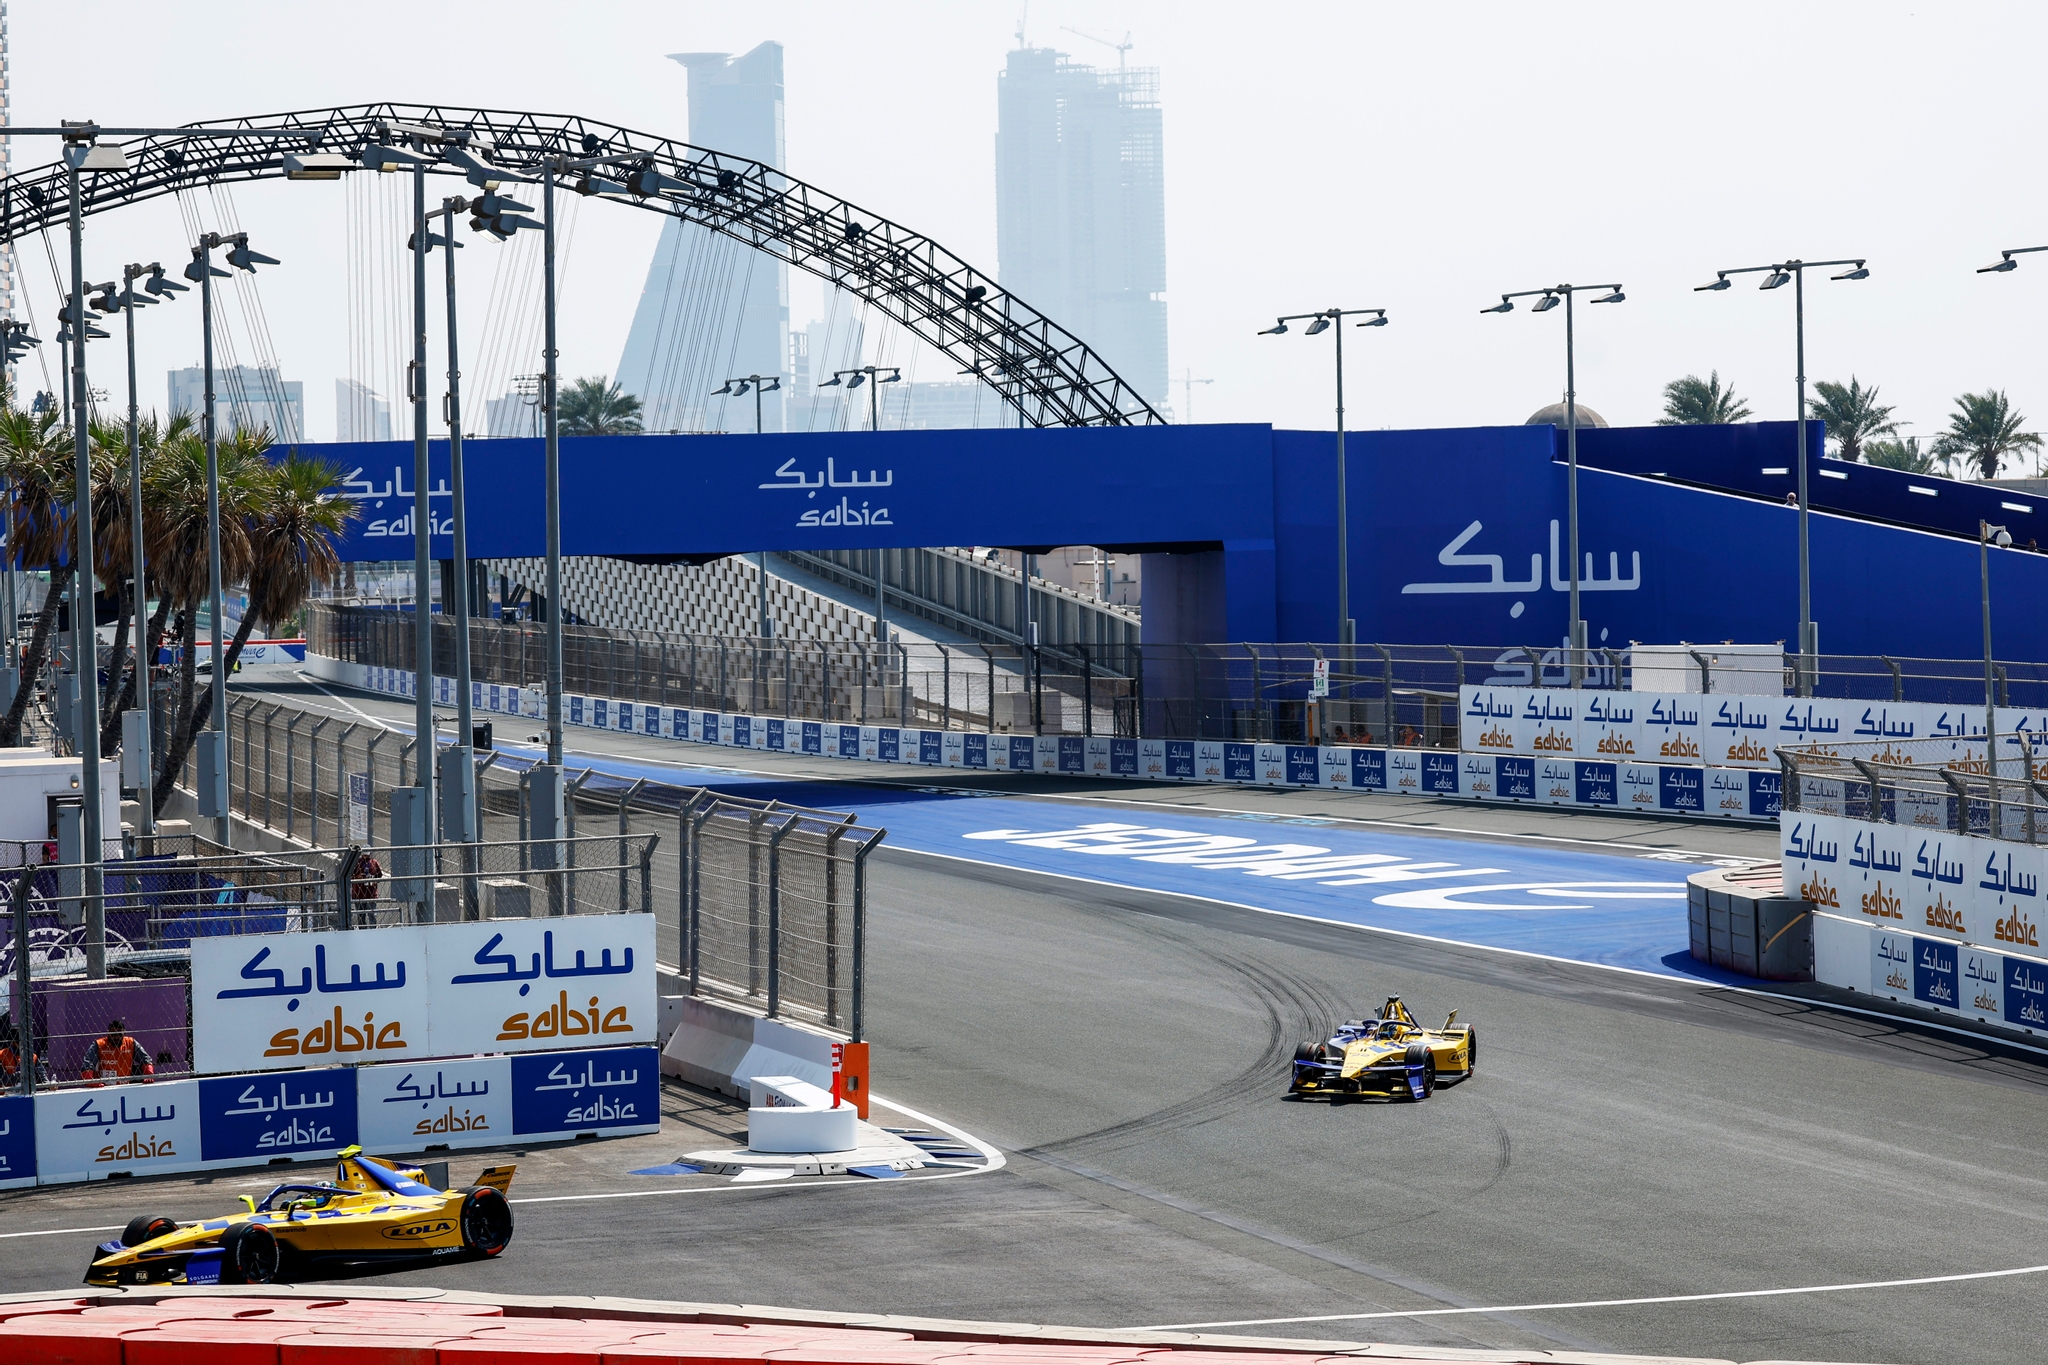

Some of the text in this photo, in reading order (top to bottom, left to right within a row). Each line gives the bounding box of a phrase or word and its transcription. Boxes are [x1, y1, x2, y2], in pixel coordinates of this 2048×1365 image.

[796, 497, 893, 526] sabic
[1479, 724, 1513, 748] sabic
[1534, 727, 1573, 751] sabic
[1597, 730, 1635, 754] sabic
[1660, 732, 1700, 757] sabic
[1727, 736, 1769, 761] sabic
[1509, 780, 1529, 795] sabic
[1549, 783, 1570, 798] sabic
[1590, 786, 1611, 801] sabic
[1632, 789, 1653, 804] sabic
[1675, 792, 1697, 807] sabic
[1719, 795, 1742, 810] sabic
[1765, 798, 1783, 813] sab
[962, 822, 1511, 886] JEDDAH
[1801, 870, 1840, 908] sabic
[1862, 881, 1903, 919] sabic
[1926, 893, 1966, 933] sabic
[1995, 905, 2038, 947] sabic
[1886, 968, 1908, 990] sabic
[1929, 978, 1951, 1001] sabic
[1974, 990, 1997, 1012] sabic
[2021, 999, 2045, 1023] sabic
[496, 990, 633, 1041] sabic
[264, 1006, 407, 1057] sabic
[413, 1106, 489, 1135] sabic
[563, 1094, 638, 1124] sabic
[256, 1117, 335, 1150] sabic
[95, 1132, 176, 1162] sabic
[390, 1222, 451, 1237] LOLA
[136, 1272, 147, 1280] FIA
